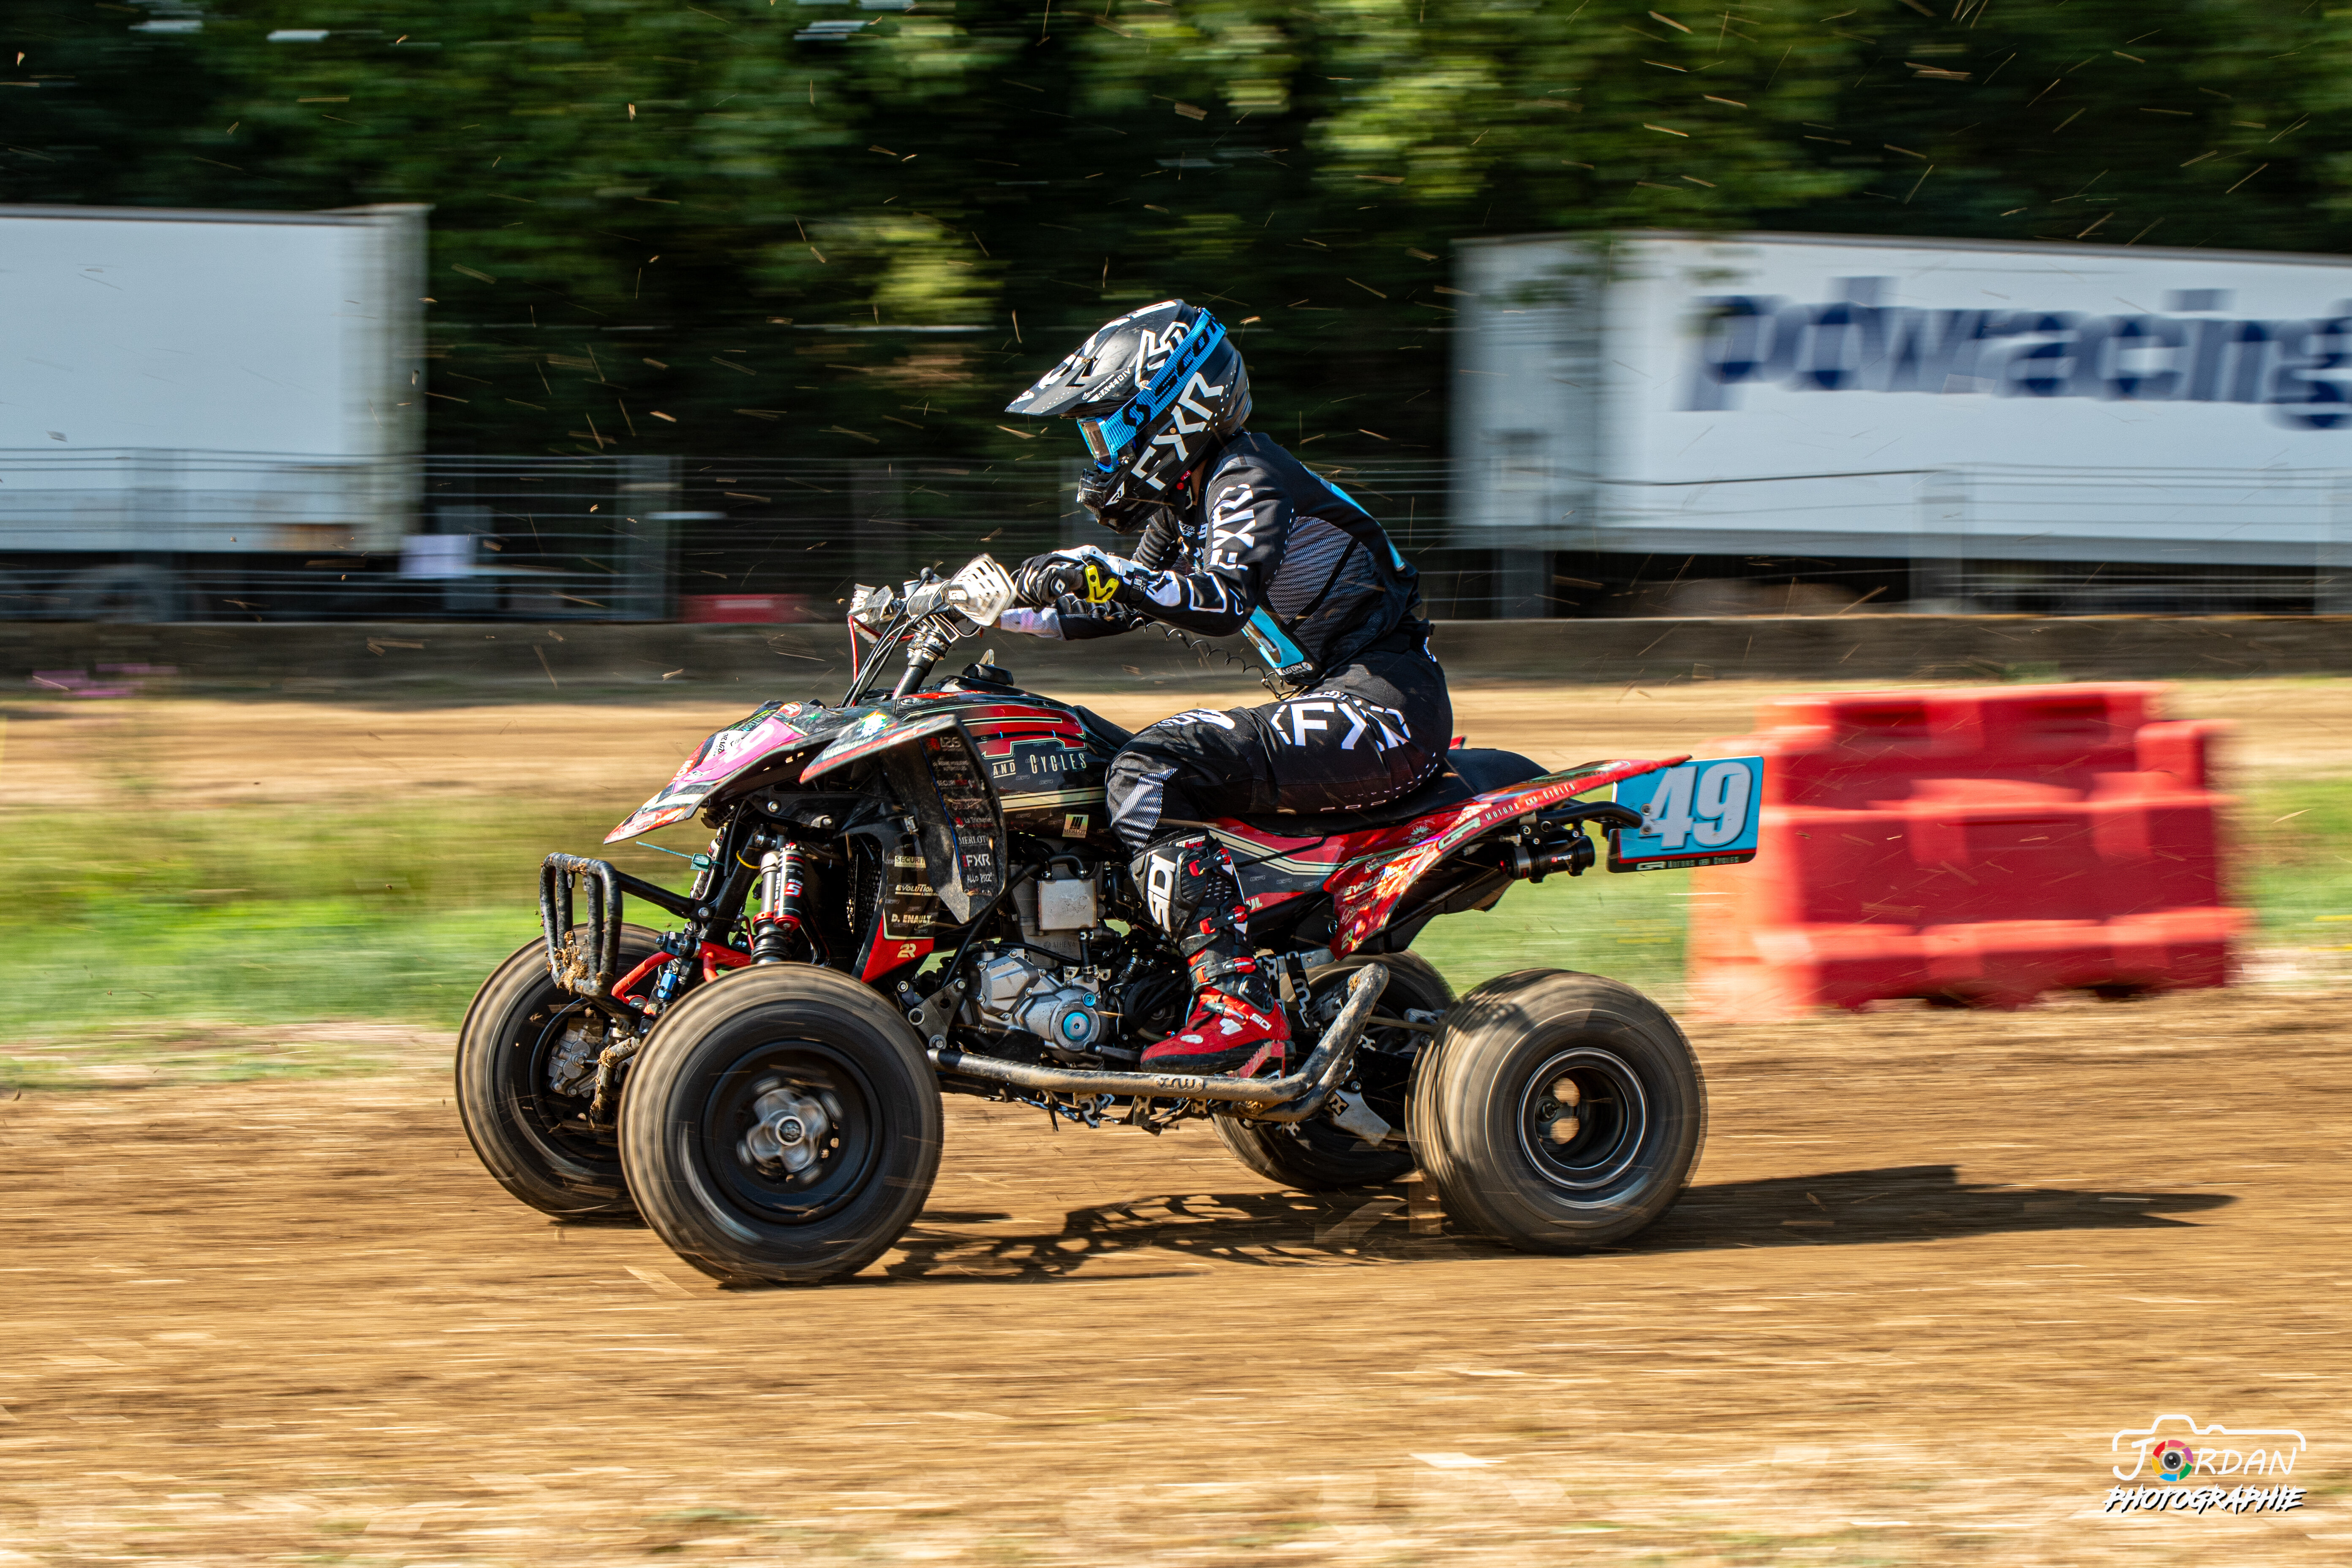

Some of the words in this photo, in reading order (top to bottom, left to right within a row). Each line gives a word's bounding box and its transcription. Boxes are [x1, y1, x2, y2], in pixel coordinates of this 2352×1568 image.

[1132, 372, 1224, 491] FXR
[993, 762, 1016, 776] AND
[1639, 762, 1753, 847] 49
[958, 836, 986, 845] MERLOT
[966, 853, 991, 866] FXR
[785, 884, 801, 896] 5
[902, 915, 932, 924] ENAULT
